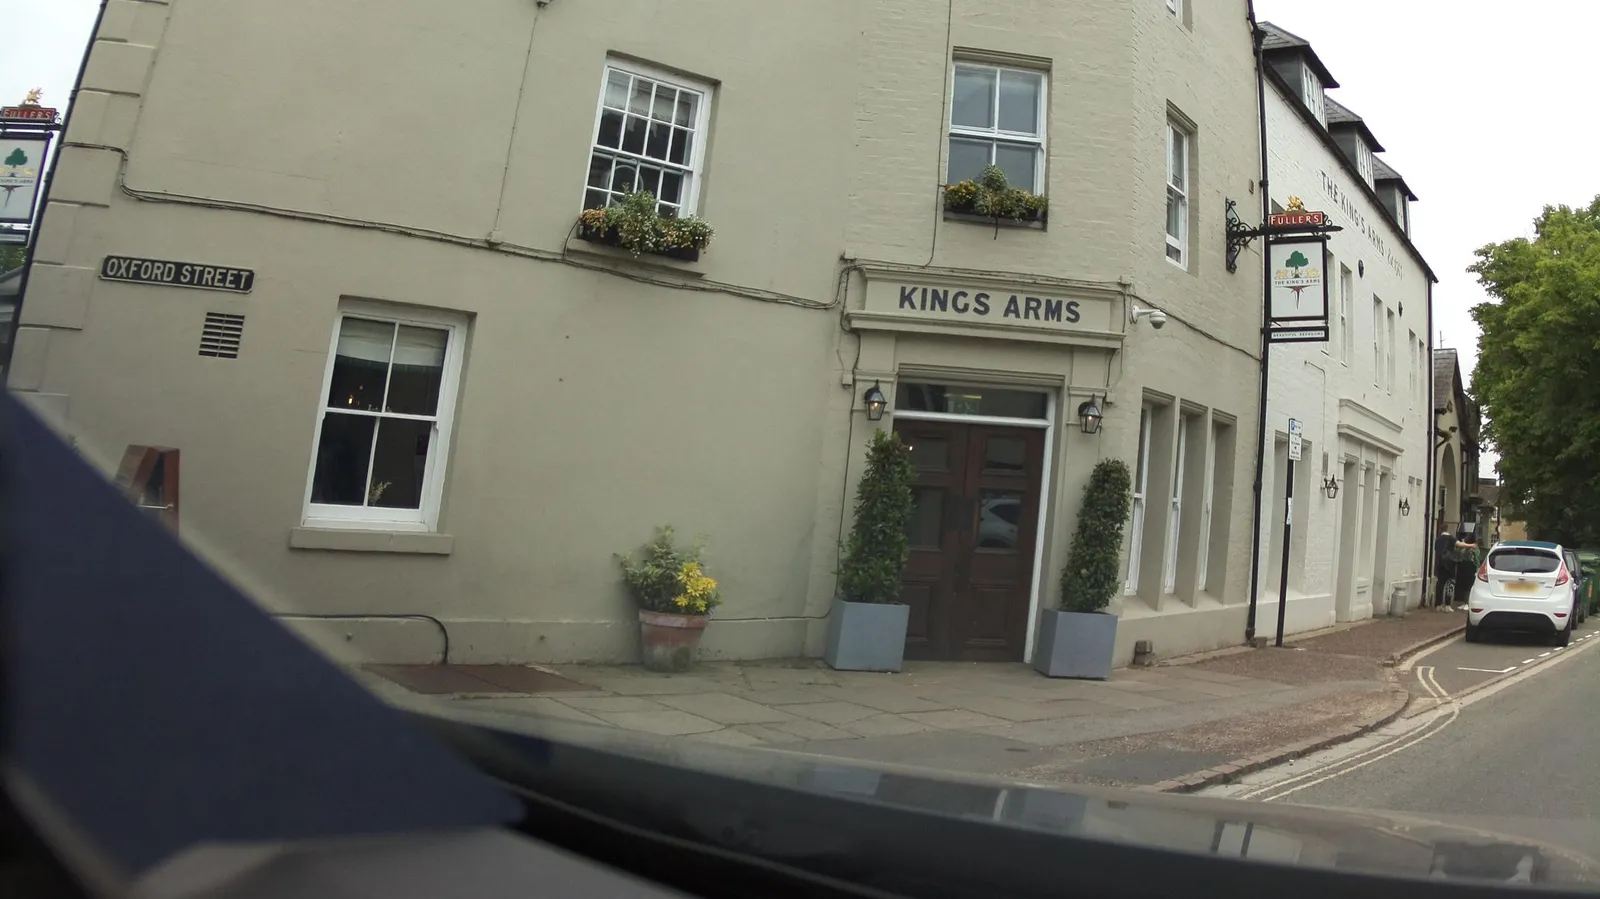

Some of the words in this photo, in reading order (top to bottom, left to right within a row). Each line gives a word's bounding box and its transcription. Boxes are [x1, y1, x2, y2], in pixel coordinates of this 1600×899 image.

[1320, 170, 1339, 205] THE
[1341, 192, 1366, 235] KING'S
[1367, 225, 1385, 257] ARMS
[106, 257, 176, 282] OXFORD
[180, 265, 250, 289] STREET
[898, 286, 991, 316] KINGS
[1002, 294, 1081, 324] ARMS
